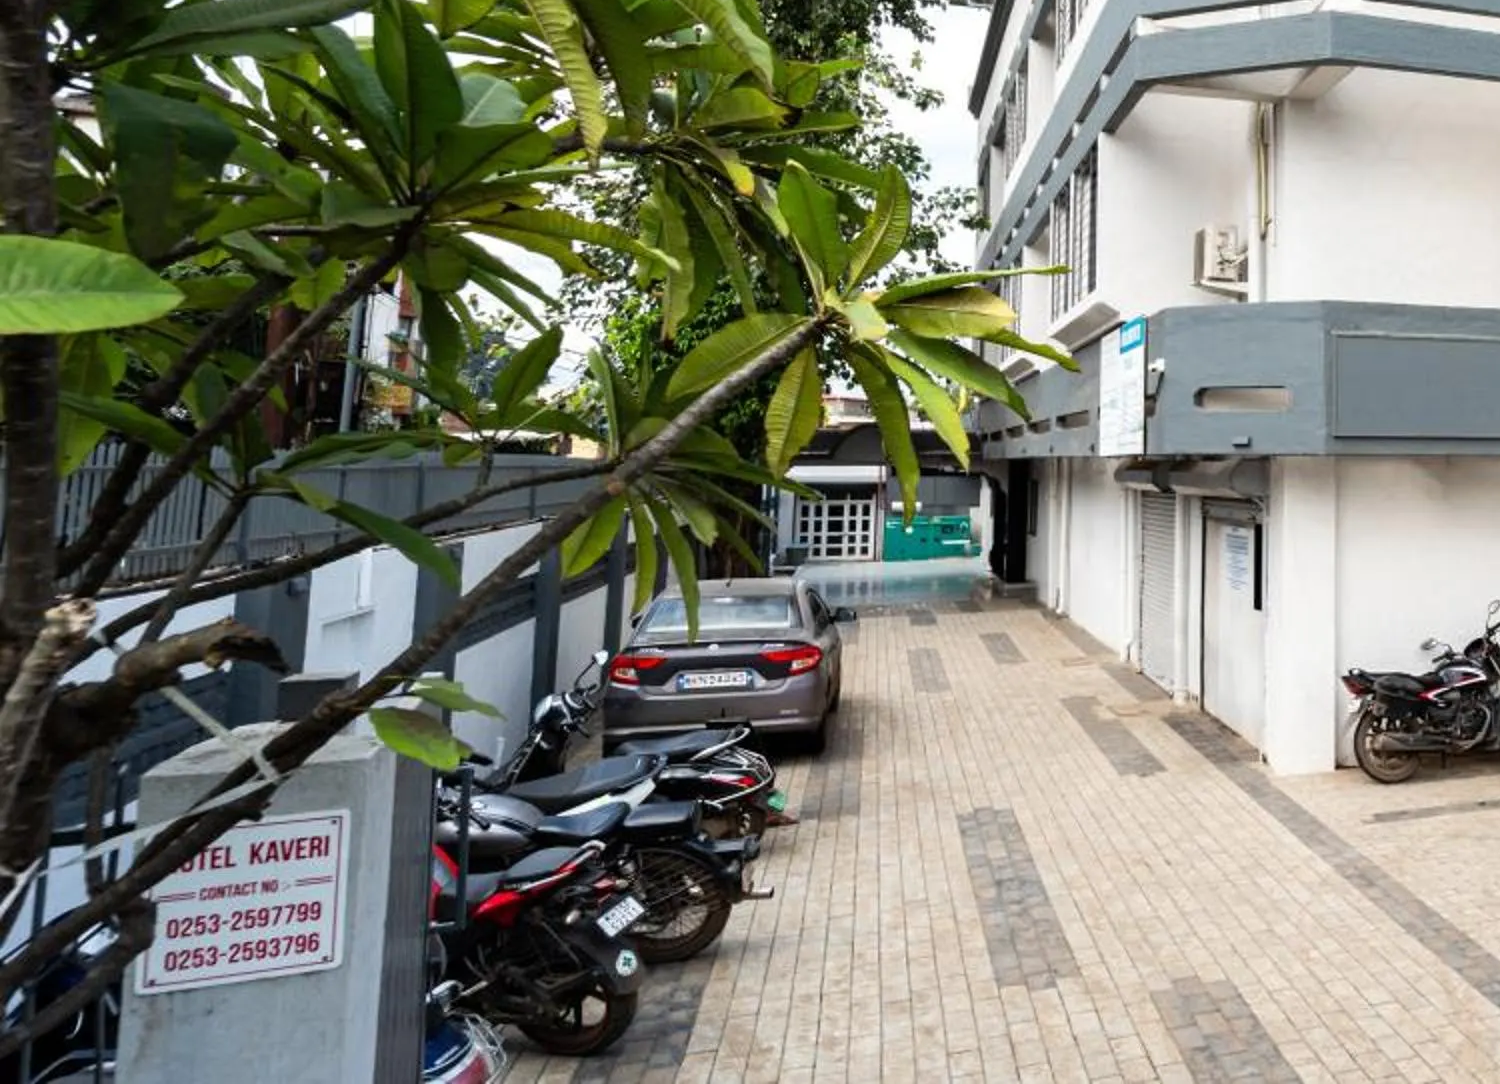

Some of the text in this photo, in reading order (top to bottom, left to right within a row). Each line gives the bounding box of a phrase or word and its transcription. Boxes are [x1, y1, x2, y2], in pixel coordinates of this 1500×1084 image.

[176, 835, 330, 874] OTEL KAVERI
[198, 881, 259, 902] CONTACT
[166, 901, 322, 939] 0253-2597799
[163, 933, 321, 972] 0253-2593796
